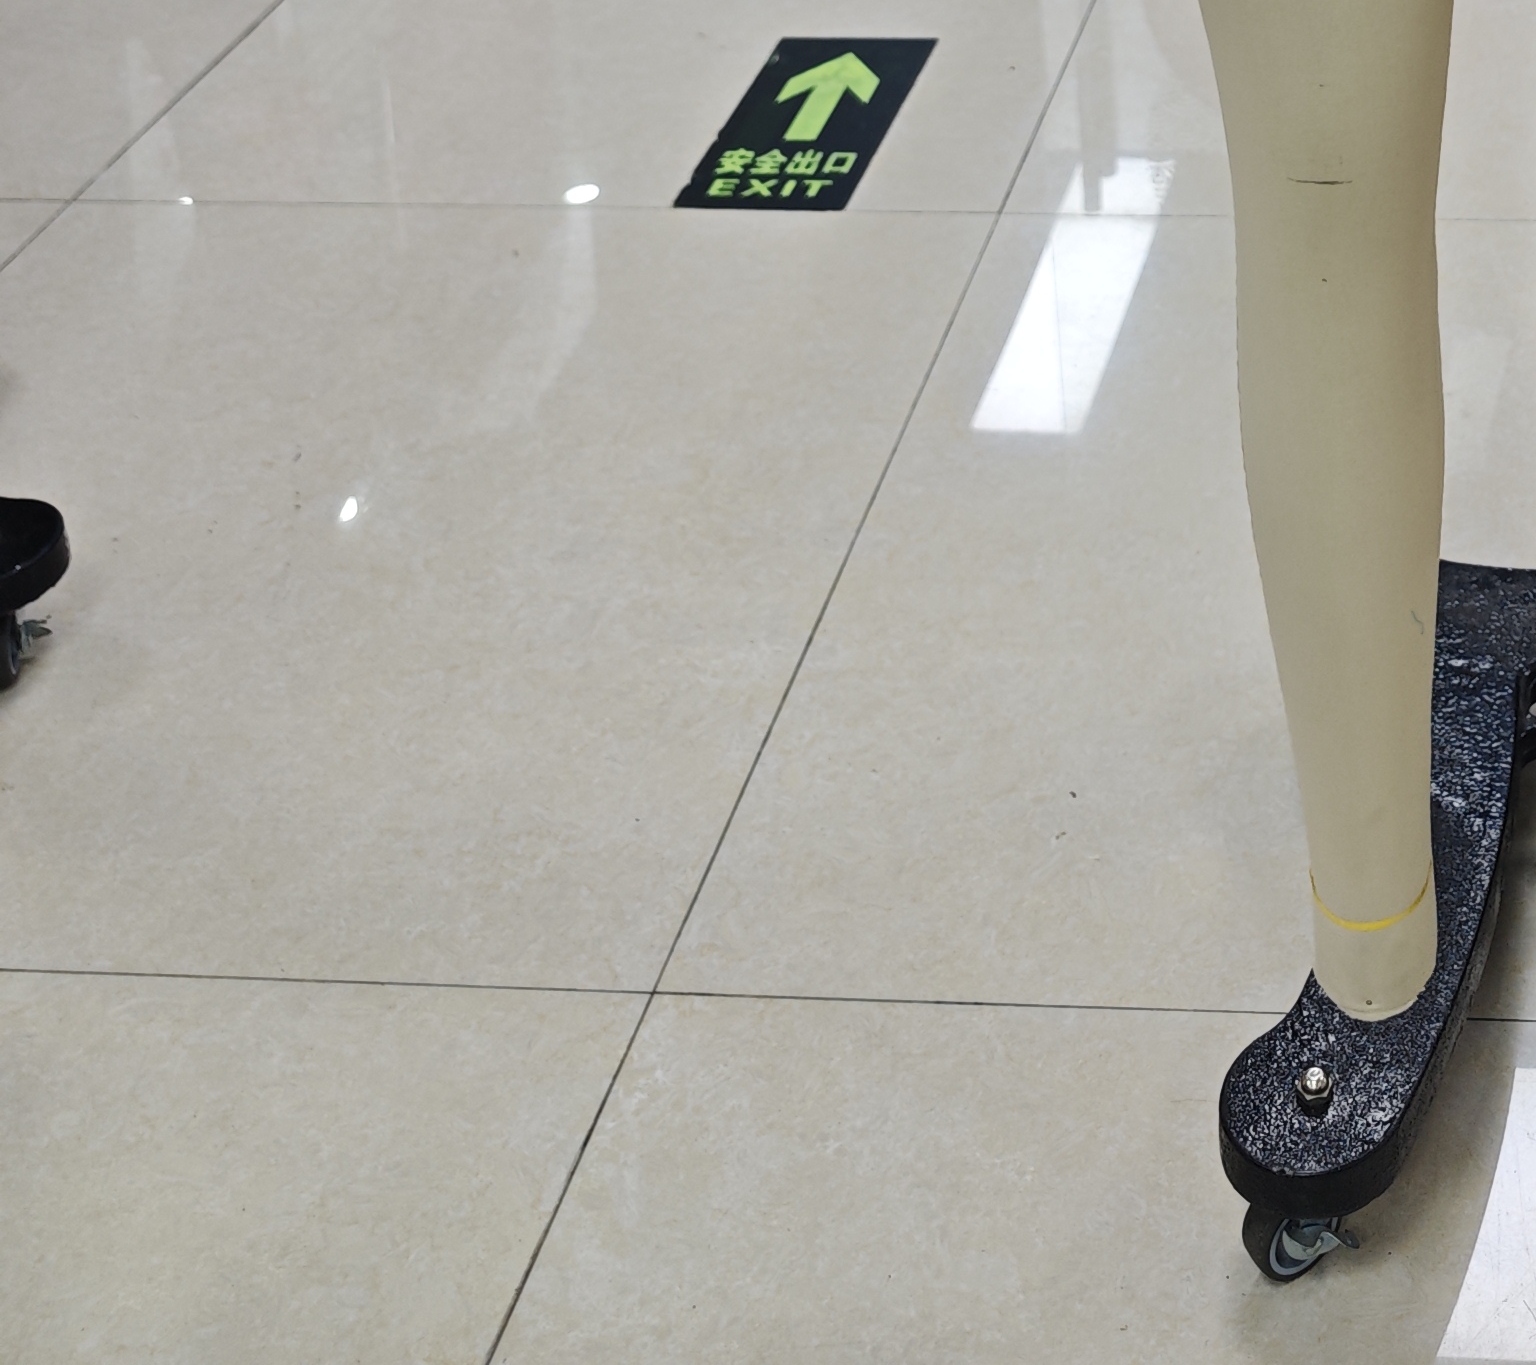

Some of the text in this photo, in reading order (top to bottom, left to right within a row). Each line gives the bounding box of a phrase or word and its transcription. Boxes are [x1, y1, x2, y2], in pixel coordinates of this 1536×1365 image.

[715, 148, 858, 175] 安全出口
[706, 178, 833, 198] EXIT
